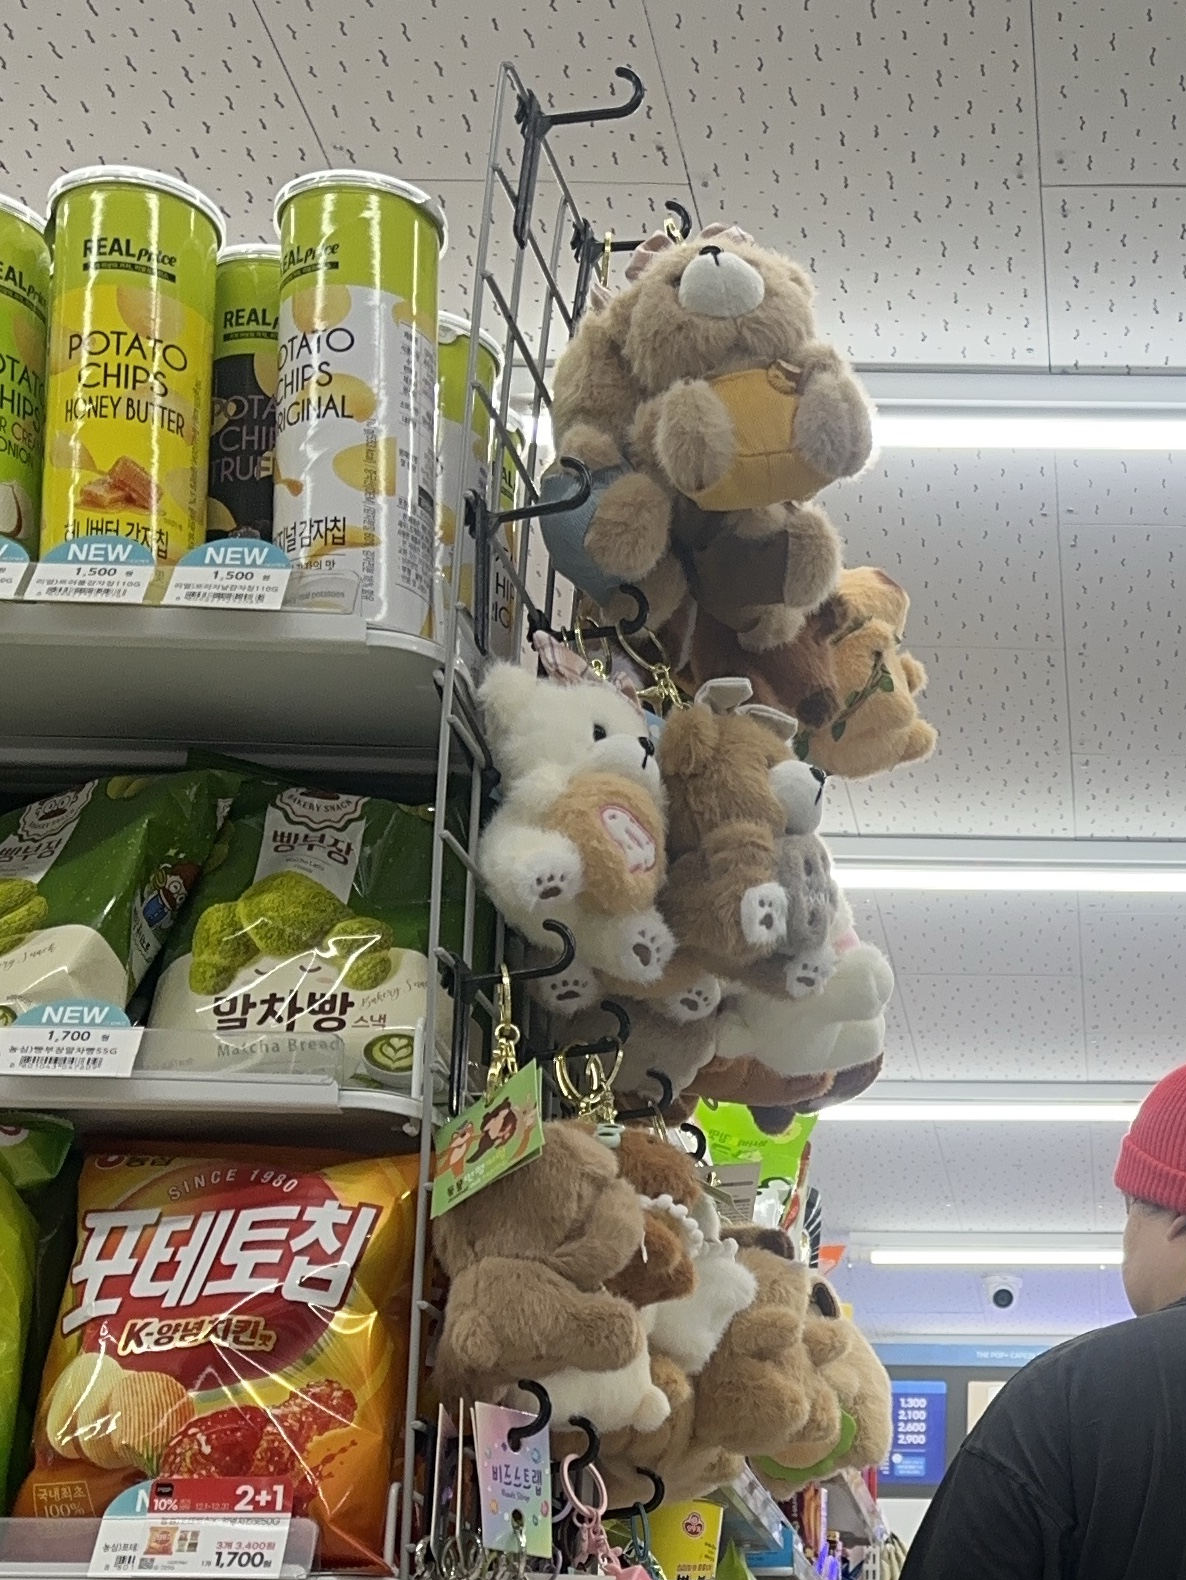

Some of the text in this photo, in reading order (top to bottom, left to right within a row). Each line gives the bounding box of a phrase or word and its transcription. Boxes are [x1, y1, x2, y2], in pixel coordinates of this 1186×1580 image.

[223, 308, 270, 329] REAL
[68, 330, 188, 372] POTATO
[279, 327, 354, 372] OTATO
[78, 362, 169, 398] CHIPS
[0, 384, 41, 433] HIPS
[65, 396, 185, 437] HONEY BUTTER
[277, 394, 353, 433] RIGINAL
[298, 515, 346, 549] 감자칩
[67, 544, 133, 563] NEW
[204, 547, 269, 567] NEW
[41, 1006, 110, 1024] NEW
[212, 988, 355, 1033] 말차빵
[351, 1013, 388, 1029] 스낵
[48, 1030, 91, 1042] 1,700
[217, 1038, 280, 1058] Matcha
[168, 1168, 299, 1200] SINCE 1980
[62, 1199, 379, 1335] 포테토칩
[492, 1462, 542, 1497] 비즈스트랩
[153, 1498, 177, 1511] 10%
[234, 1485, 284, 1512] 2+1
